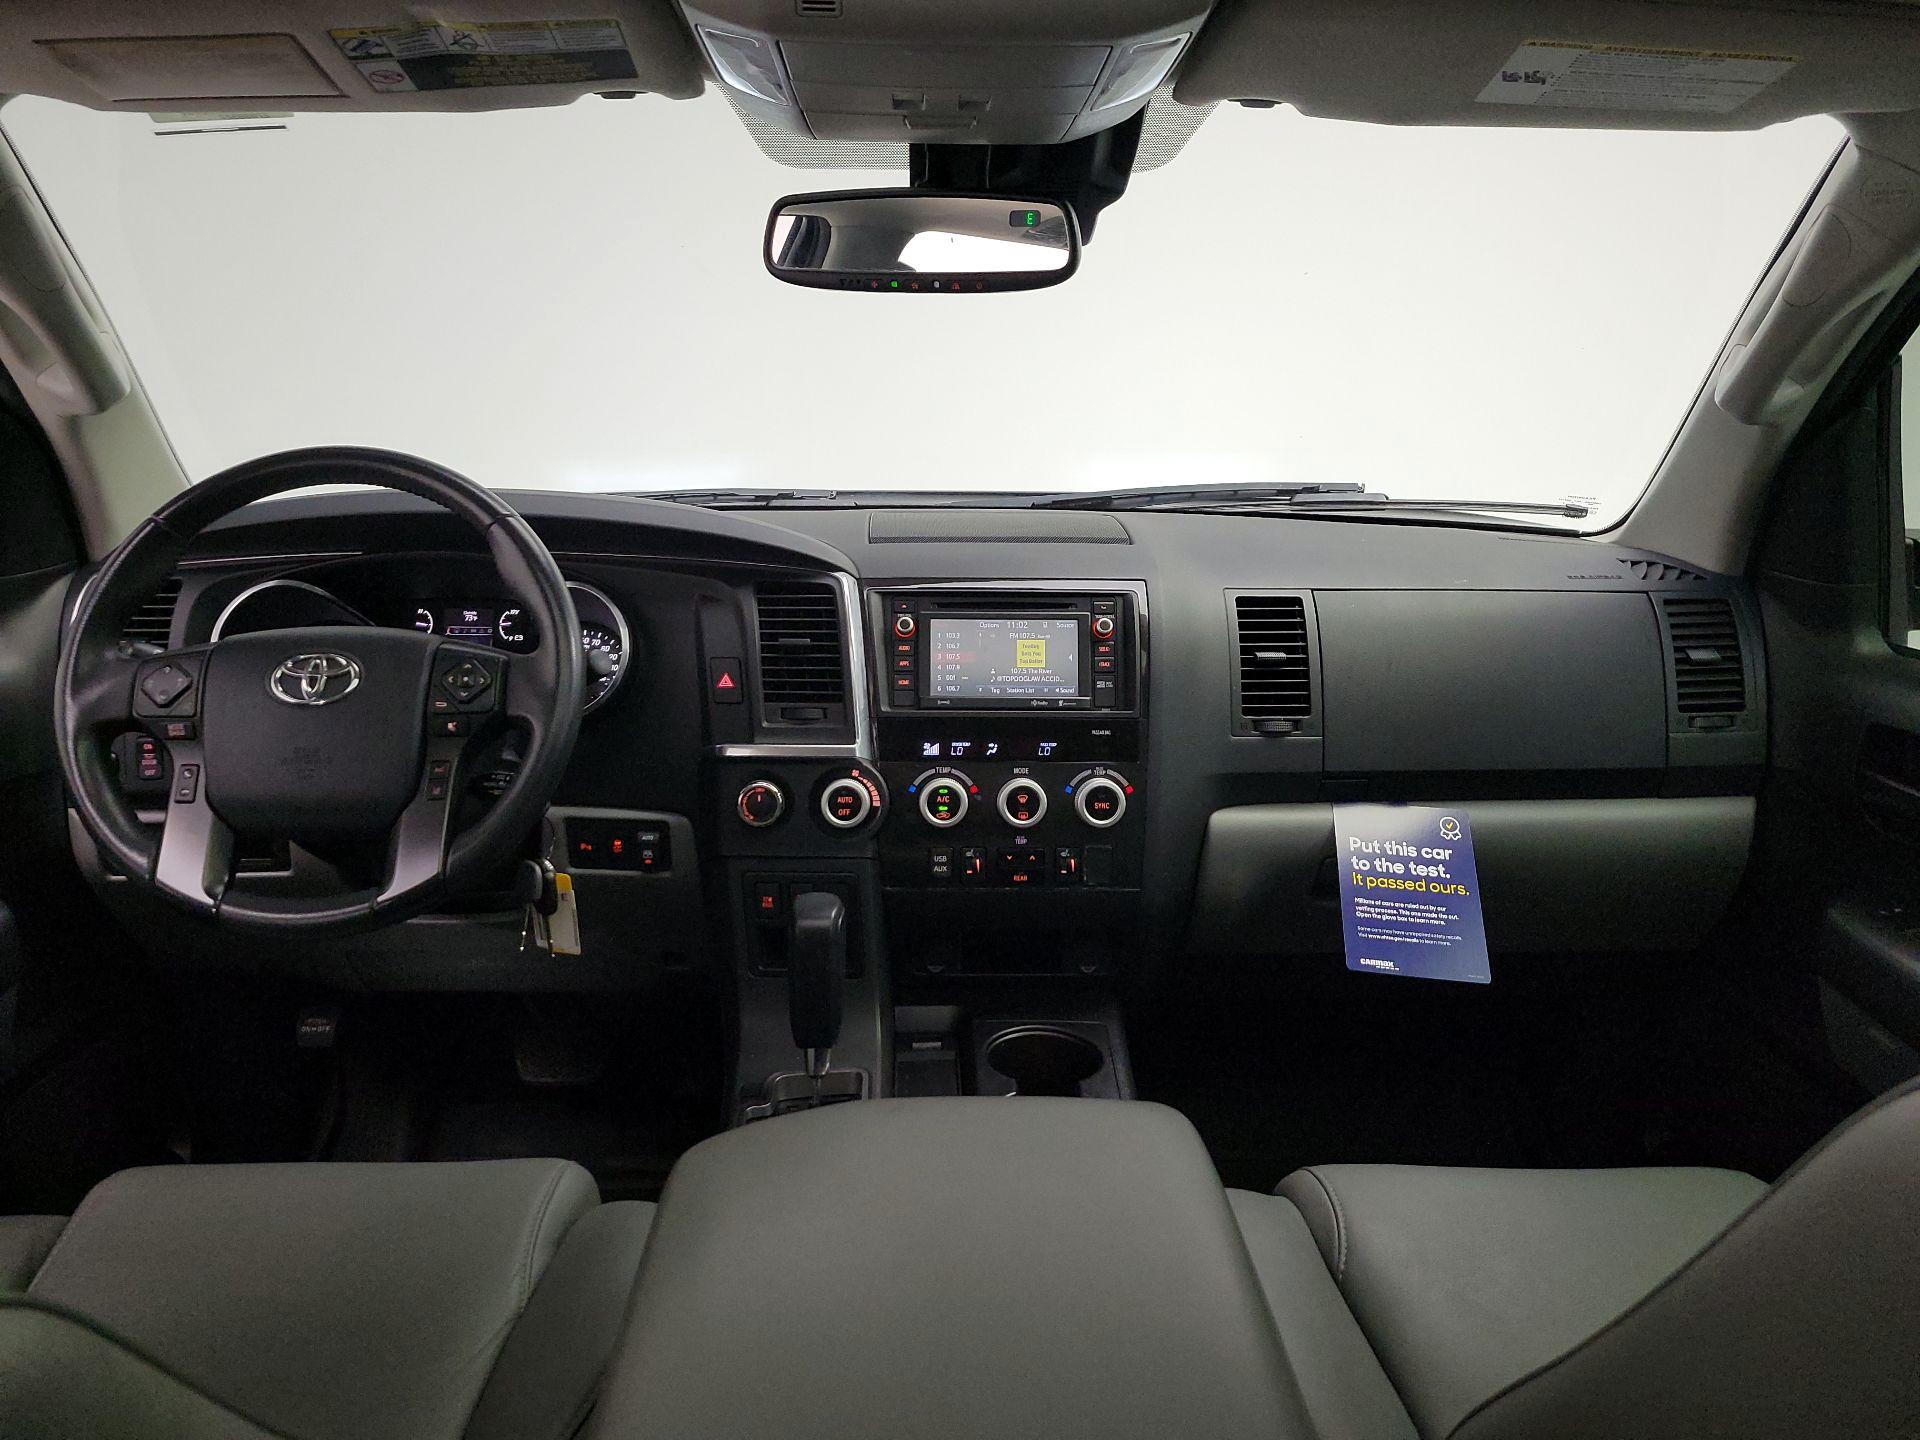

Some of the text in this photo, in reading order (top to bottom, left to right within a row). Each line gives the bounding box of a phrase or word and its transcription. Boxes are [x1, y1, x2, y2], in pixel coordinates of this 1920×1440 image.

[979, 622, 1000, 630] Options
[1007, 621, 1028, 629] 11:02
[935, 766, 952, 774] TEMP
[1013, 767, 1030, 775] MODE
[837, 796, 853, 804] AUTO
[936, 795, 950, 803] A/C
[1094, 802, 1110, 810] SYNC
[838, 808, 851, 816] OFF
[1349, 836, 1453, 860] Put this car
[934, 855, 947, 863] USB
[1350, 855, 1451, 879] to the test.
[1352, 872, 1470, 896] It passed ours.
[1354, 897, 1375, 905] Millions
[1429, 904, 1437, 912] by
[1355, 911, 1372, 919] Open
[1381, 913, 1397, 921] glove
